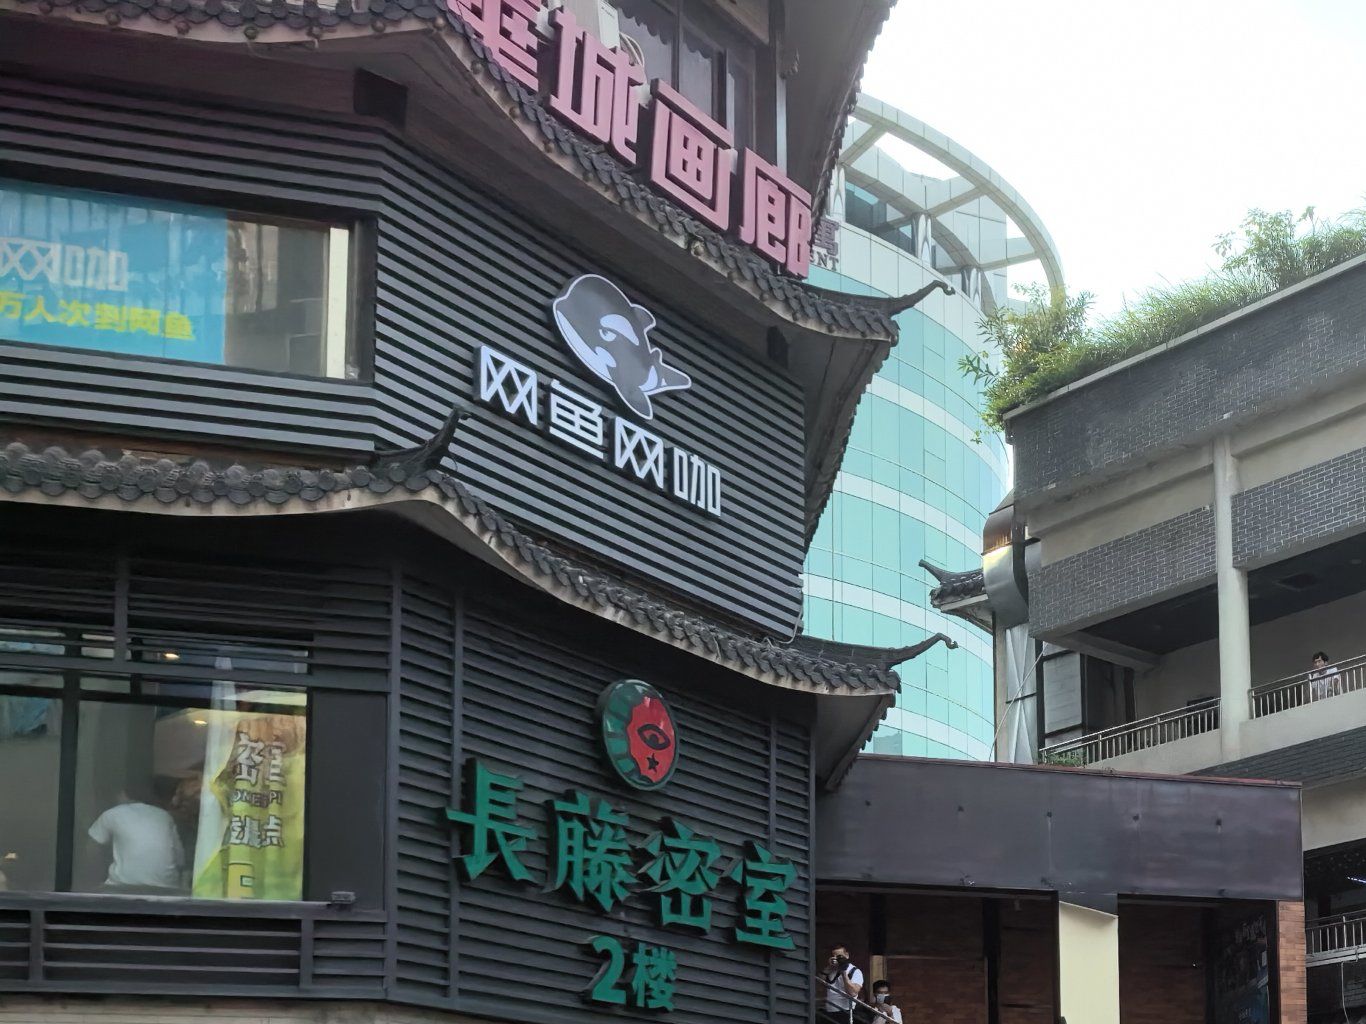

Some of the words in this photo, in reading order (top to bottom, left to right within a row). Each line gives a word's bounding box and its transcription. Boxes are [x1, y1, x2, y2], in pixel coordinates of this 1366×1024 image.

[480, 345, 722, 517] 网鱼网咖
[588, 934, 679, 1012] 2楼
